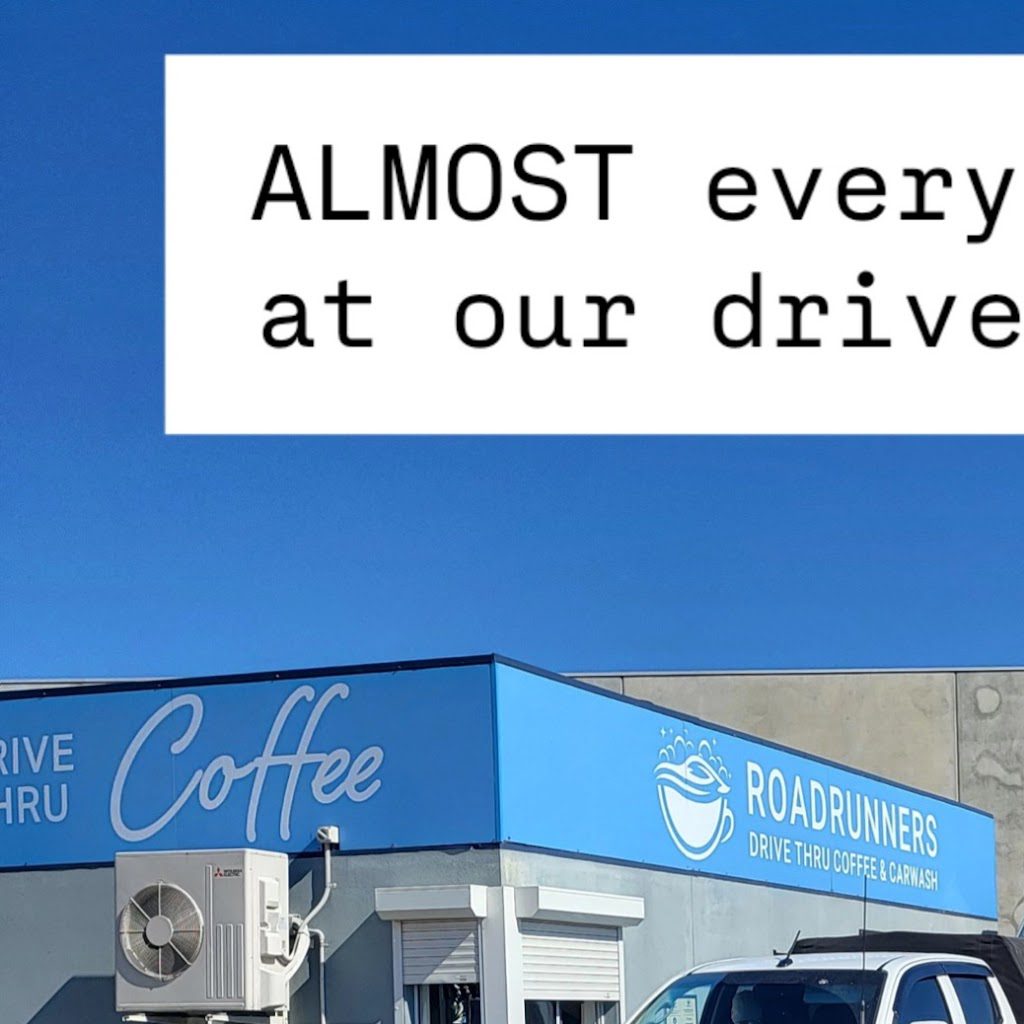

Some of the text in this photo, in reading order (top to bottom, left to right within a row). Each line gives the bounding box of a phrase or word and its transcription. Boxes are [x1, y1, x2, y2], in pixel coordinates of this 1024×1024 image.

[108, 681, 385, 844] Coffee
[746, 760, 938, 858] ROADRUNNERS
[749, 831, 938, 892] DRIVE THRU COFFEE & CARWASH
